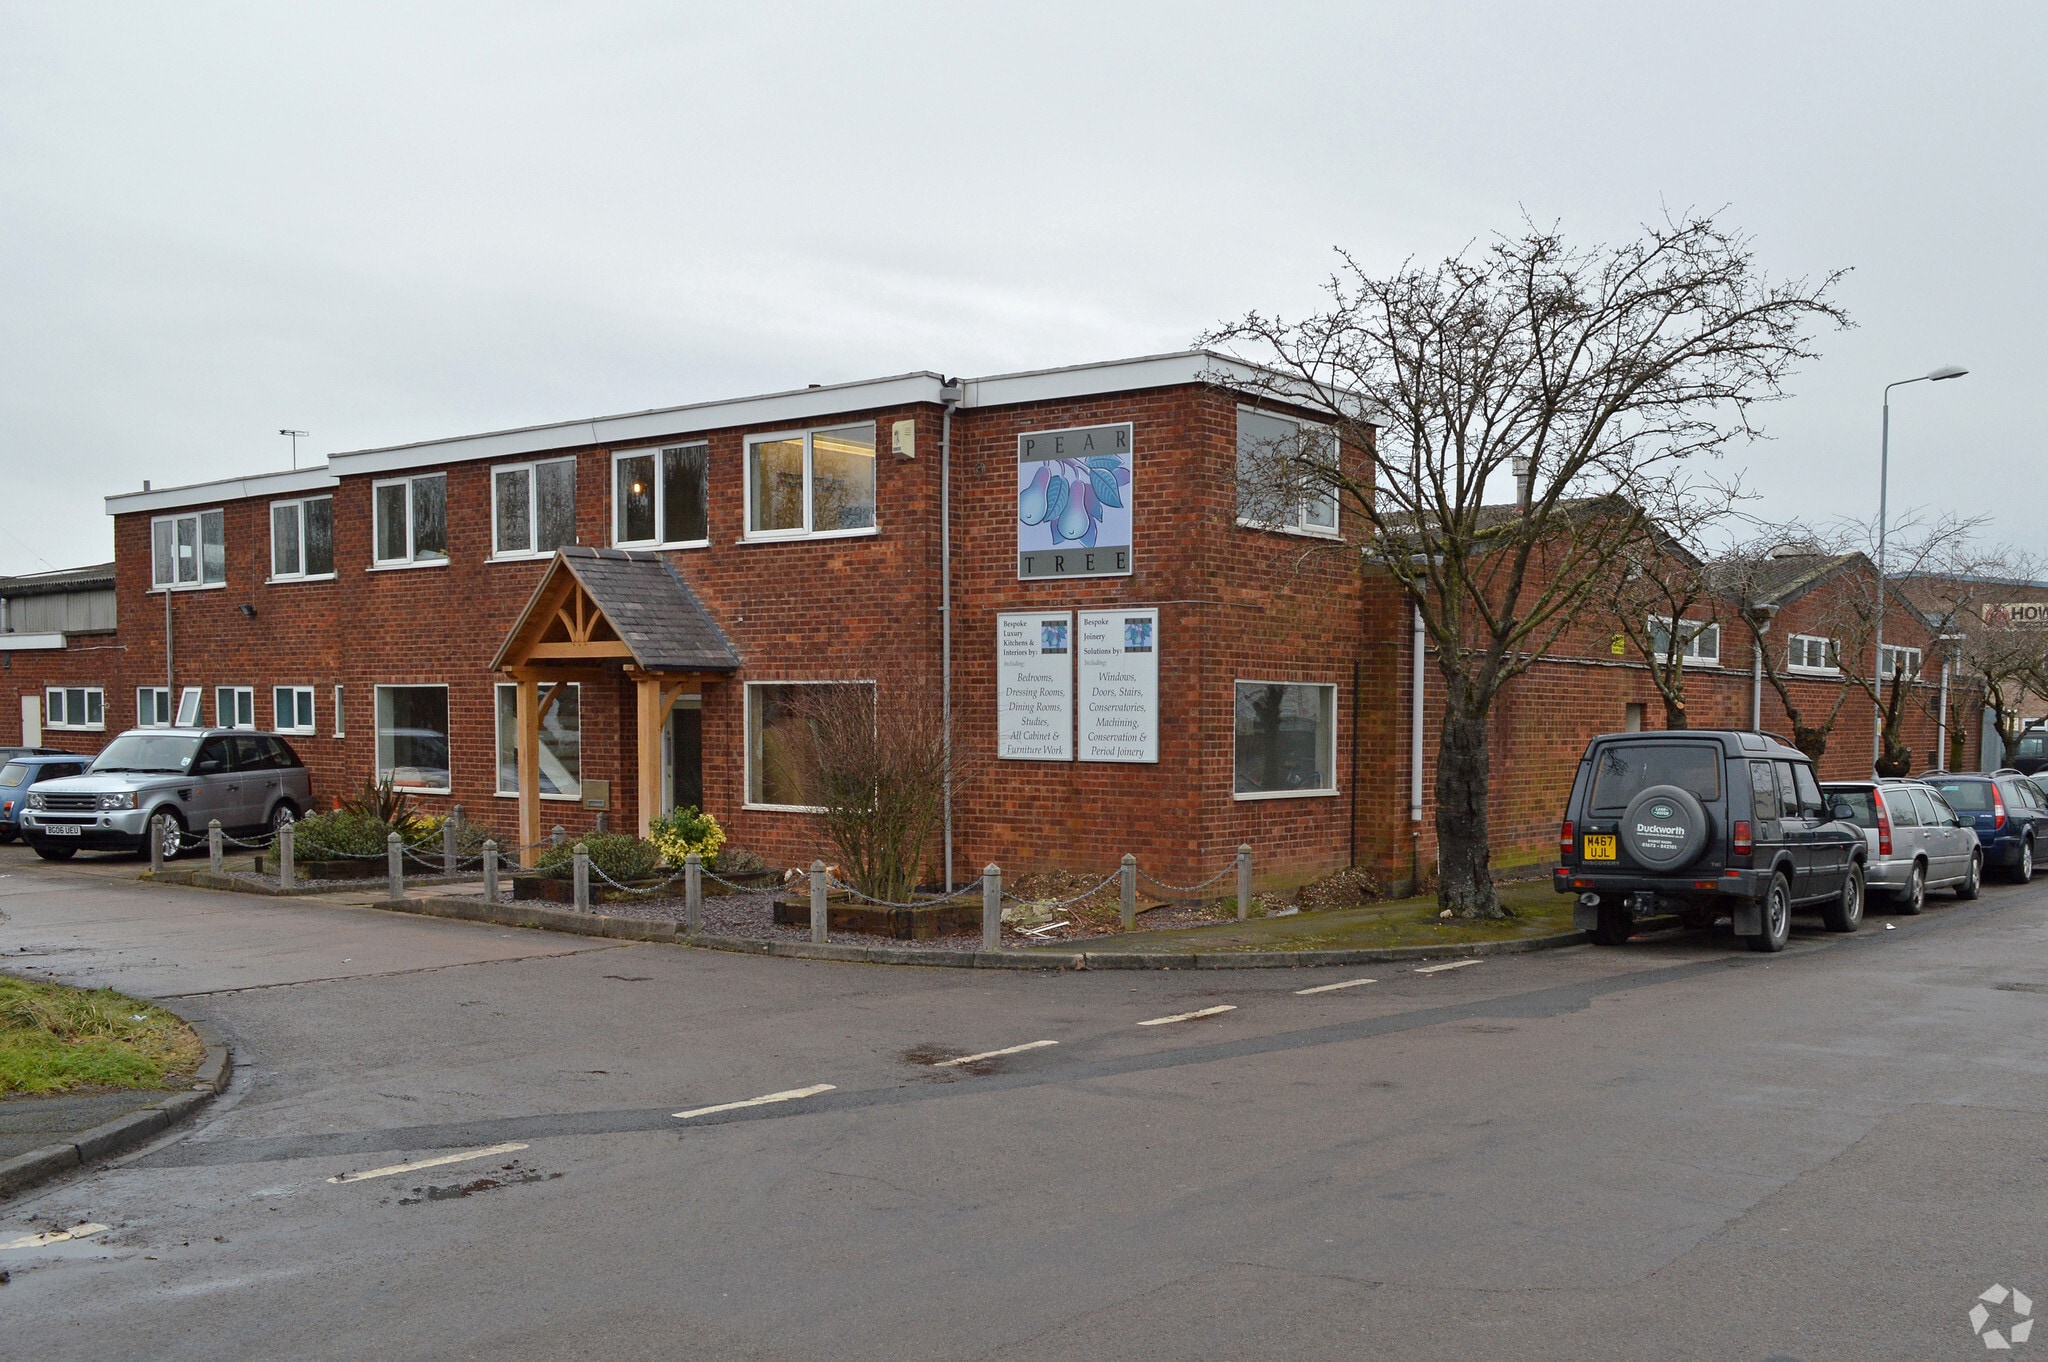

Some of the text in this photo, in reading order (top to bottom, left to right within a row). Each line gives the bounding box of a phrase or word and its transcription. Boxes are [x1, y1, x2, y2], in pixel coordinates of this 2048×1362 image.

[1025, 430, 1126, 457] PEAR
[1024, 551, 1126, 574] TREE
[1003, 620, 1027, 629] Bespoke
[1083, 618, 1109, 627] Bespoke
[1003, 630, 1023, 638] Luxury
[1083, 632, 1105, 642] Joinery
[1028, 648, 1038, 657] by:
[1083, 647, 1112, 655] Solutions
[1112, 647, 1122, 656] by:
[1017, 672, 1054, 682] Bedrooms,
[1099, 672, 1137, 682] Windows,
[1006, 687, 1065, 699] Dressing Rooms,
[1092, 686, 1144, 698] Doors, Stairs,
[1008, 702, 1062, 714] Dining Rooms,
[1088, 702, 1146, 712] Conservatories,
[1021, 716, 1049, 727] Studies,
[1095, 717, 1140, 730] Machining,
[1010, 731, 1060, 740] All Cabinet &
[1087, 731, 1147, 742] Conservation &
[1007, 744, 1063, 755] Furniture Work
[1091, 745, 1145, 759] Period Joinery
[48, 826, 64, 834] BG06
[1636, 823, 1685, 835] Duckworth
[1587, 836, 1613, 847] M467
[1590, 847, 1610, 858] UJL
